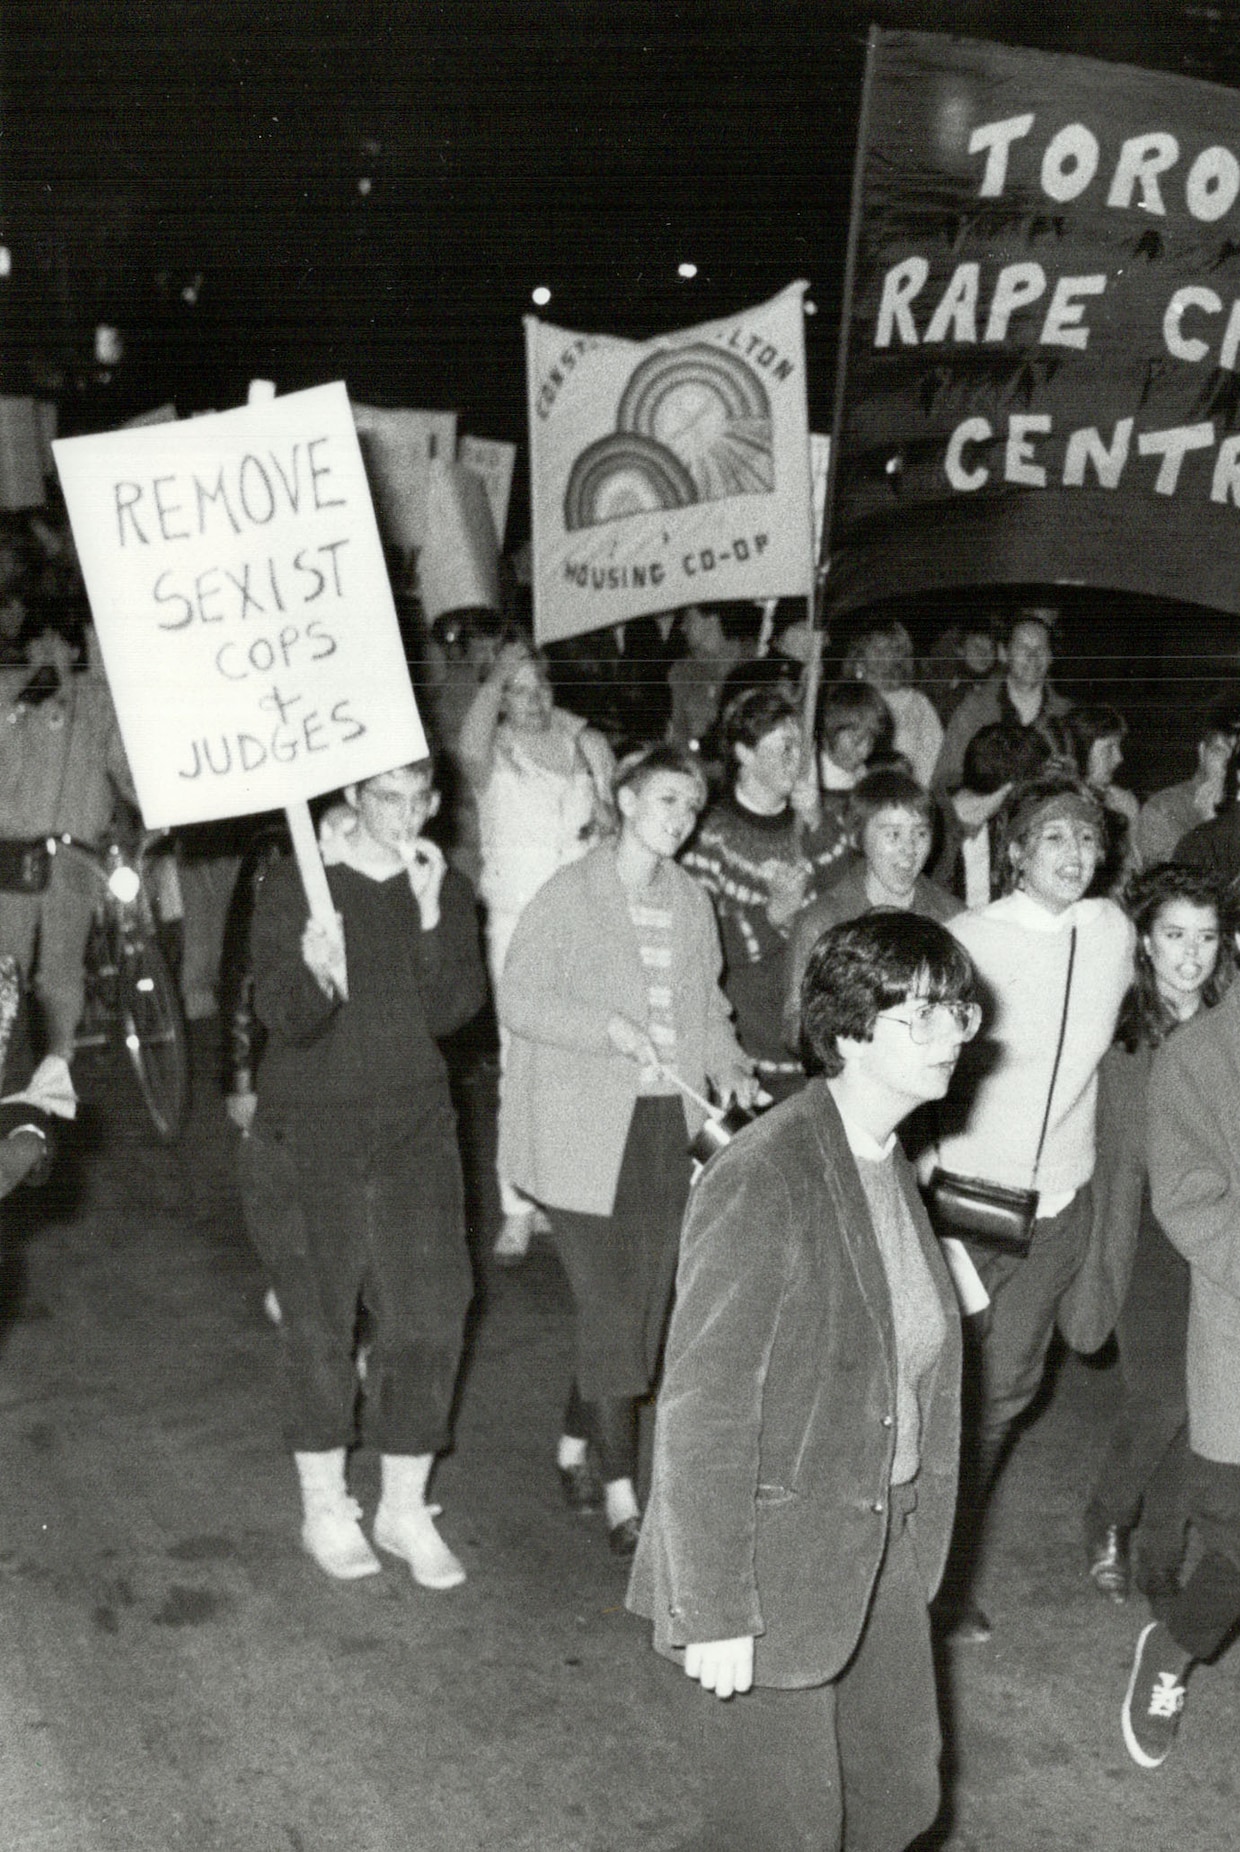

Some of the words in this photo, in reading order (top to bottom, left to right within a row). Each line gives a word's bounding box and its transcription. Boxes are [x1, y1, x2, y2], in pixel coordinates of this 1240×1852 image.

[874, 256, 1107, 350] RAPE
[717, 327, 796, 382] LTON
[114, 437, 347, 547] REMOVE
[153, 539, 350, 631] SEXIST
[563, 560, 665, 590] HOUSING
[682, 533, 769, 577] CO-OP
[216, 621, 337, 680] COPS
[178, 700, 366, 779] JUDGES
